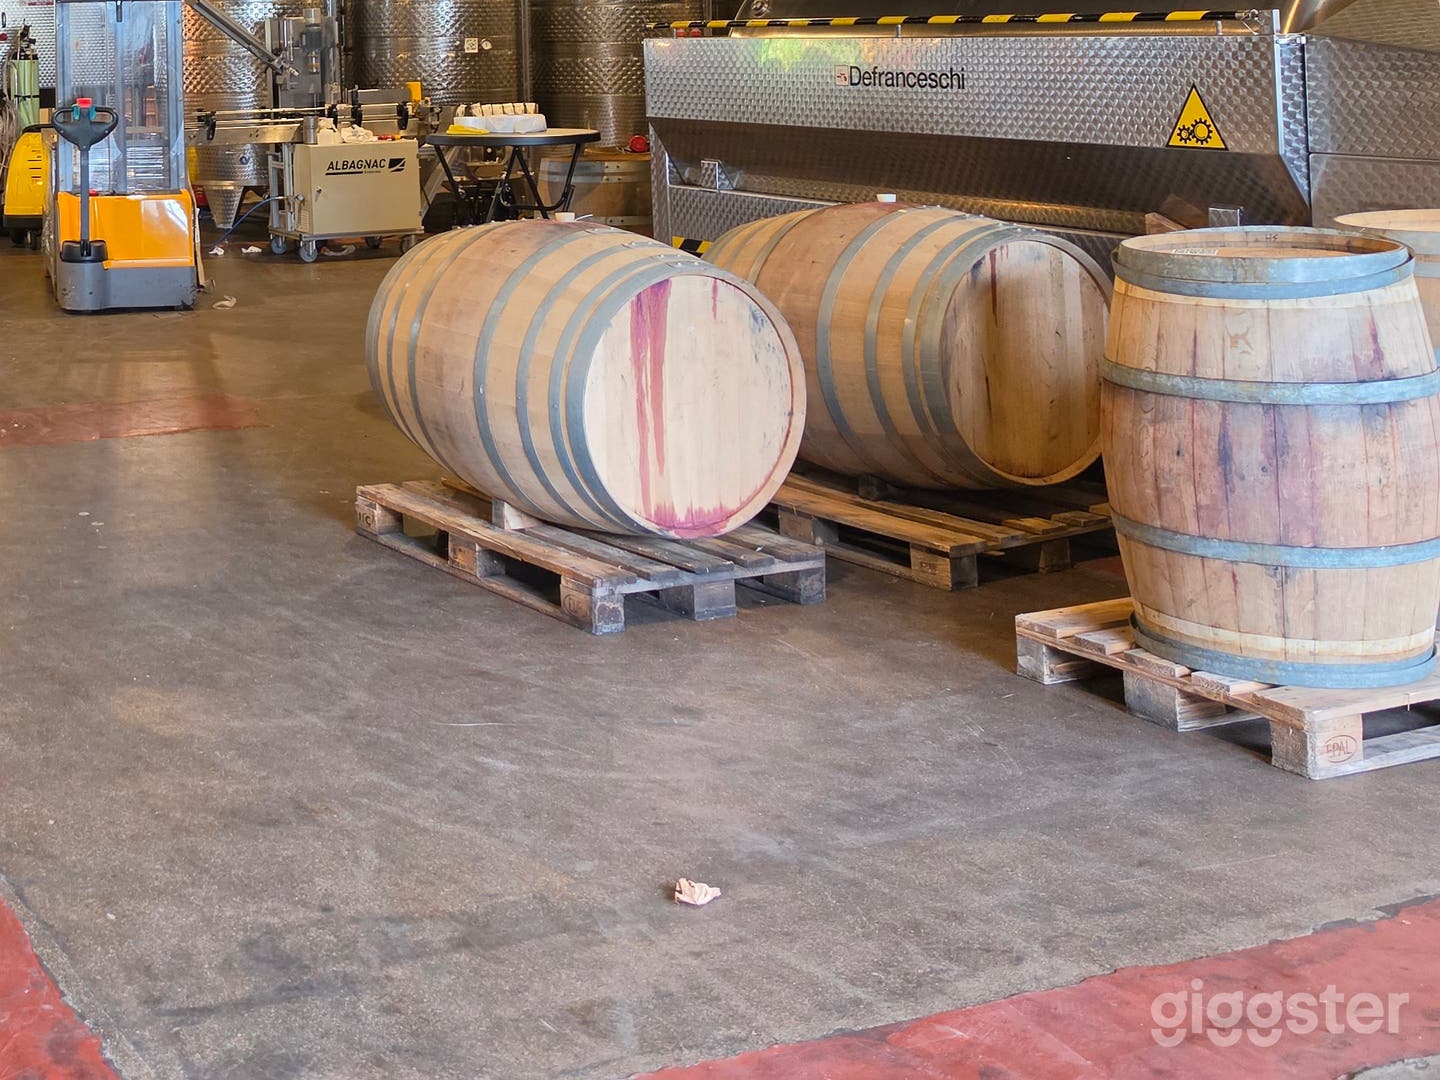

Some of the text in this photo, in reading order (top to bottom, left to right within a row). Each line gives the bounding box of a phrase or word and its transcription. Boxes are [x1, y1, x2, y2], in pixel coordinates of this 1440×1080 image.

[849, 66, 965, 89] Defranceschi
[327, 159, 386, 171] ALBAGNAC
[1326, 739, 1353, 757] EPAL
